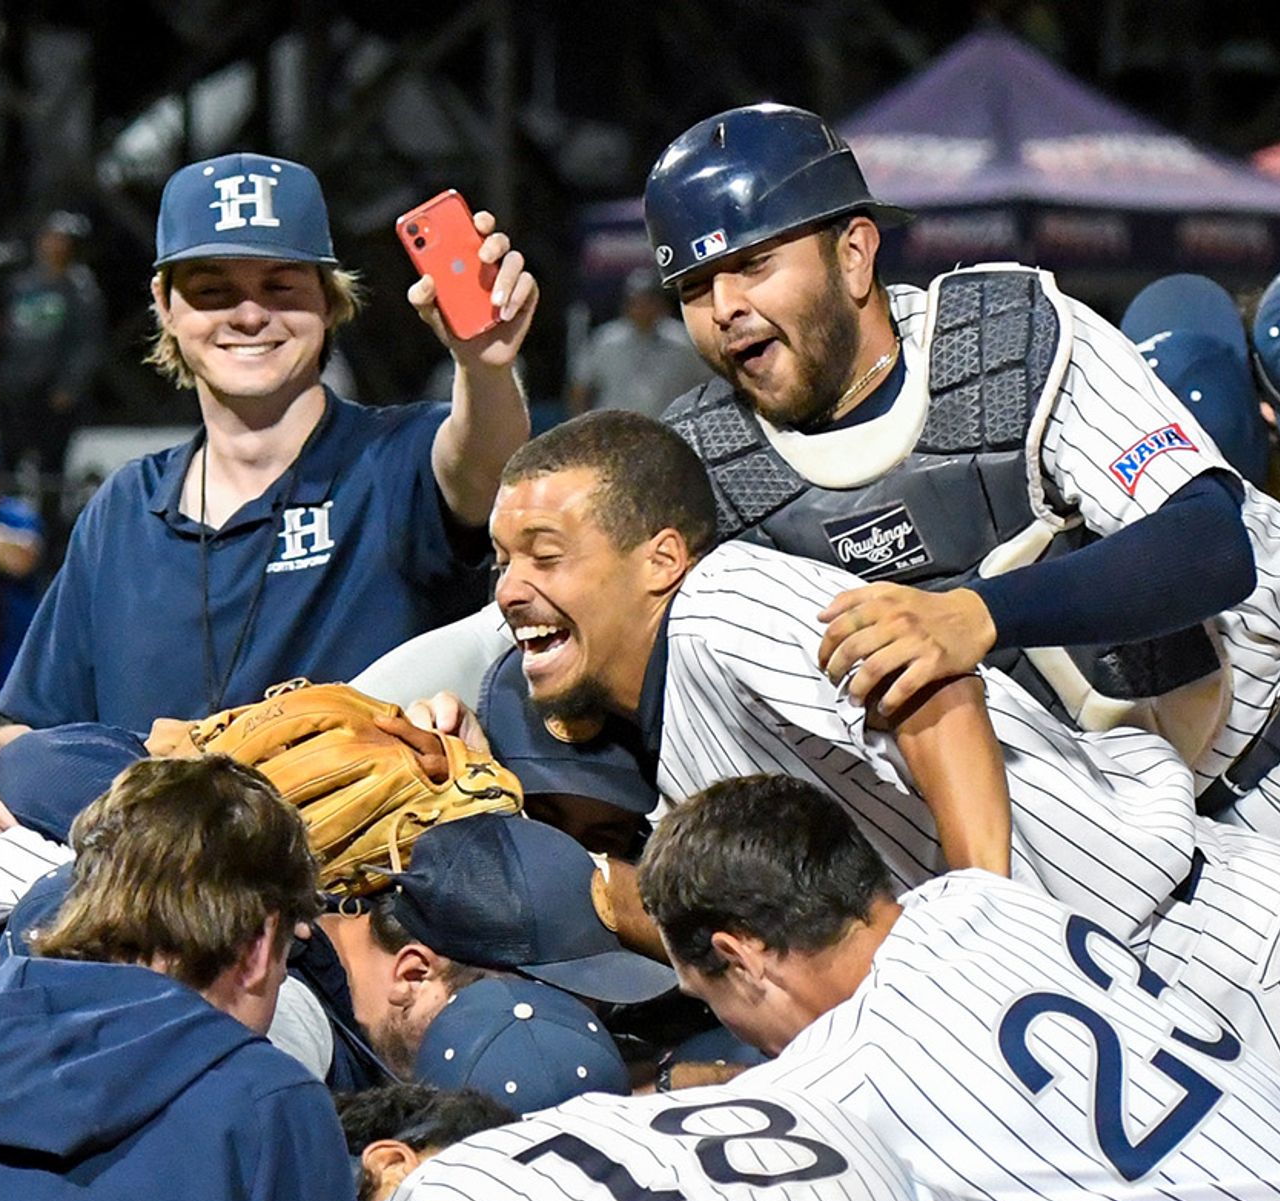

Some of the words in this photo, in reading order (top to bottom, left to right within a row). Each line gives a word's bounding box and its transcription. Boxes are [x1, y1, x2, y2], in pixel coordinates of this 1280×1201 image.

[209, 173, 280, 232] H
[1114, 428, 1192, 484] NAIA
[278, 500, 336, 560] H
[837, 521, 914, 563] Rawlings
[265, 560, 295, 574] PORTS
[997, 913, 1243, 1184] 23
